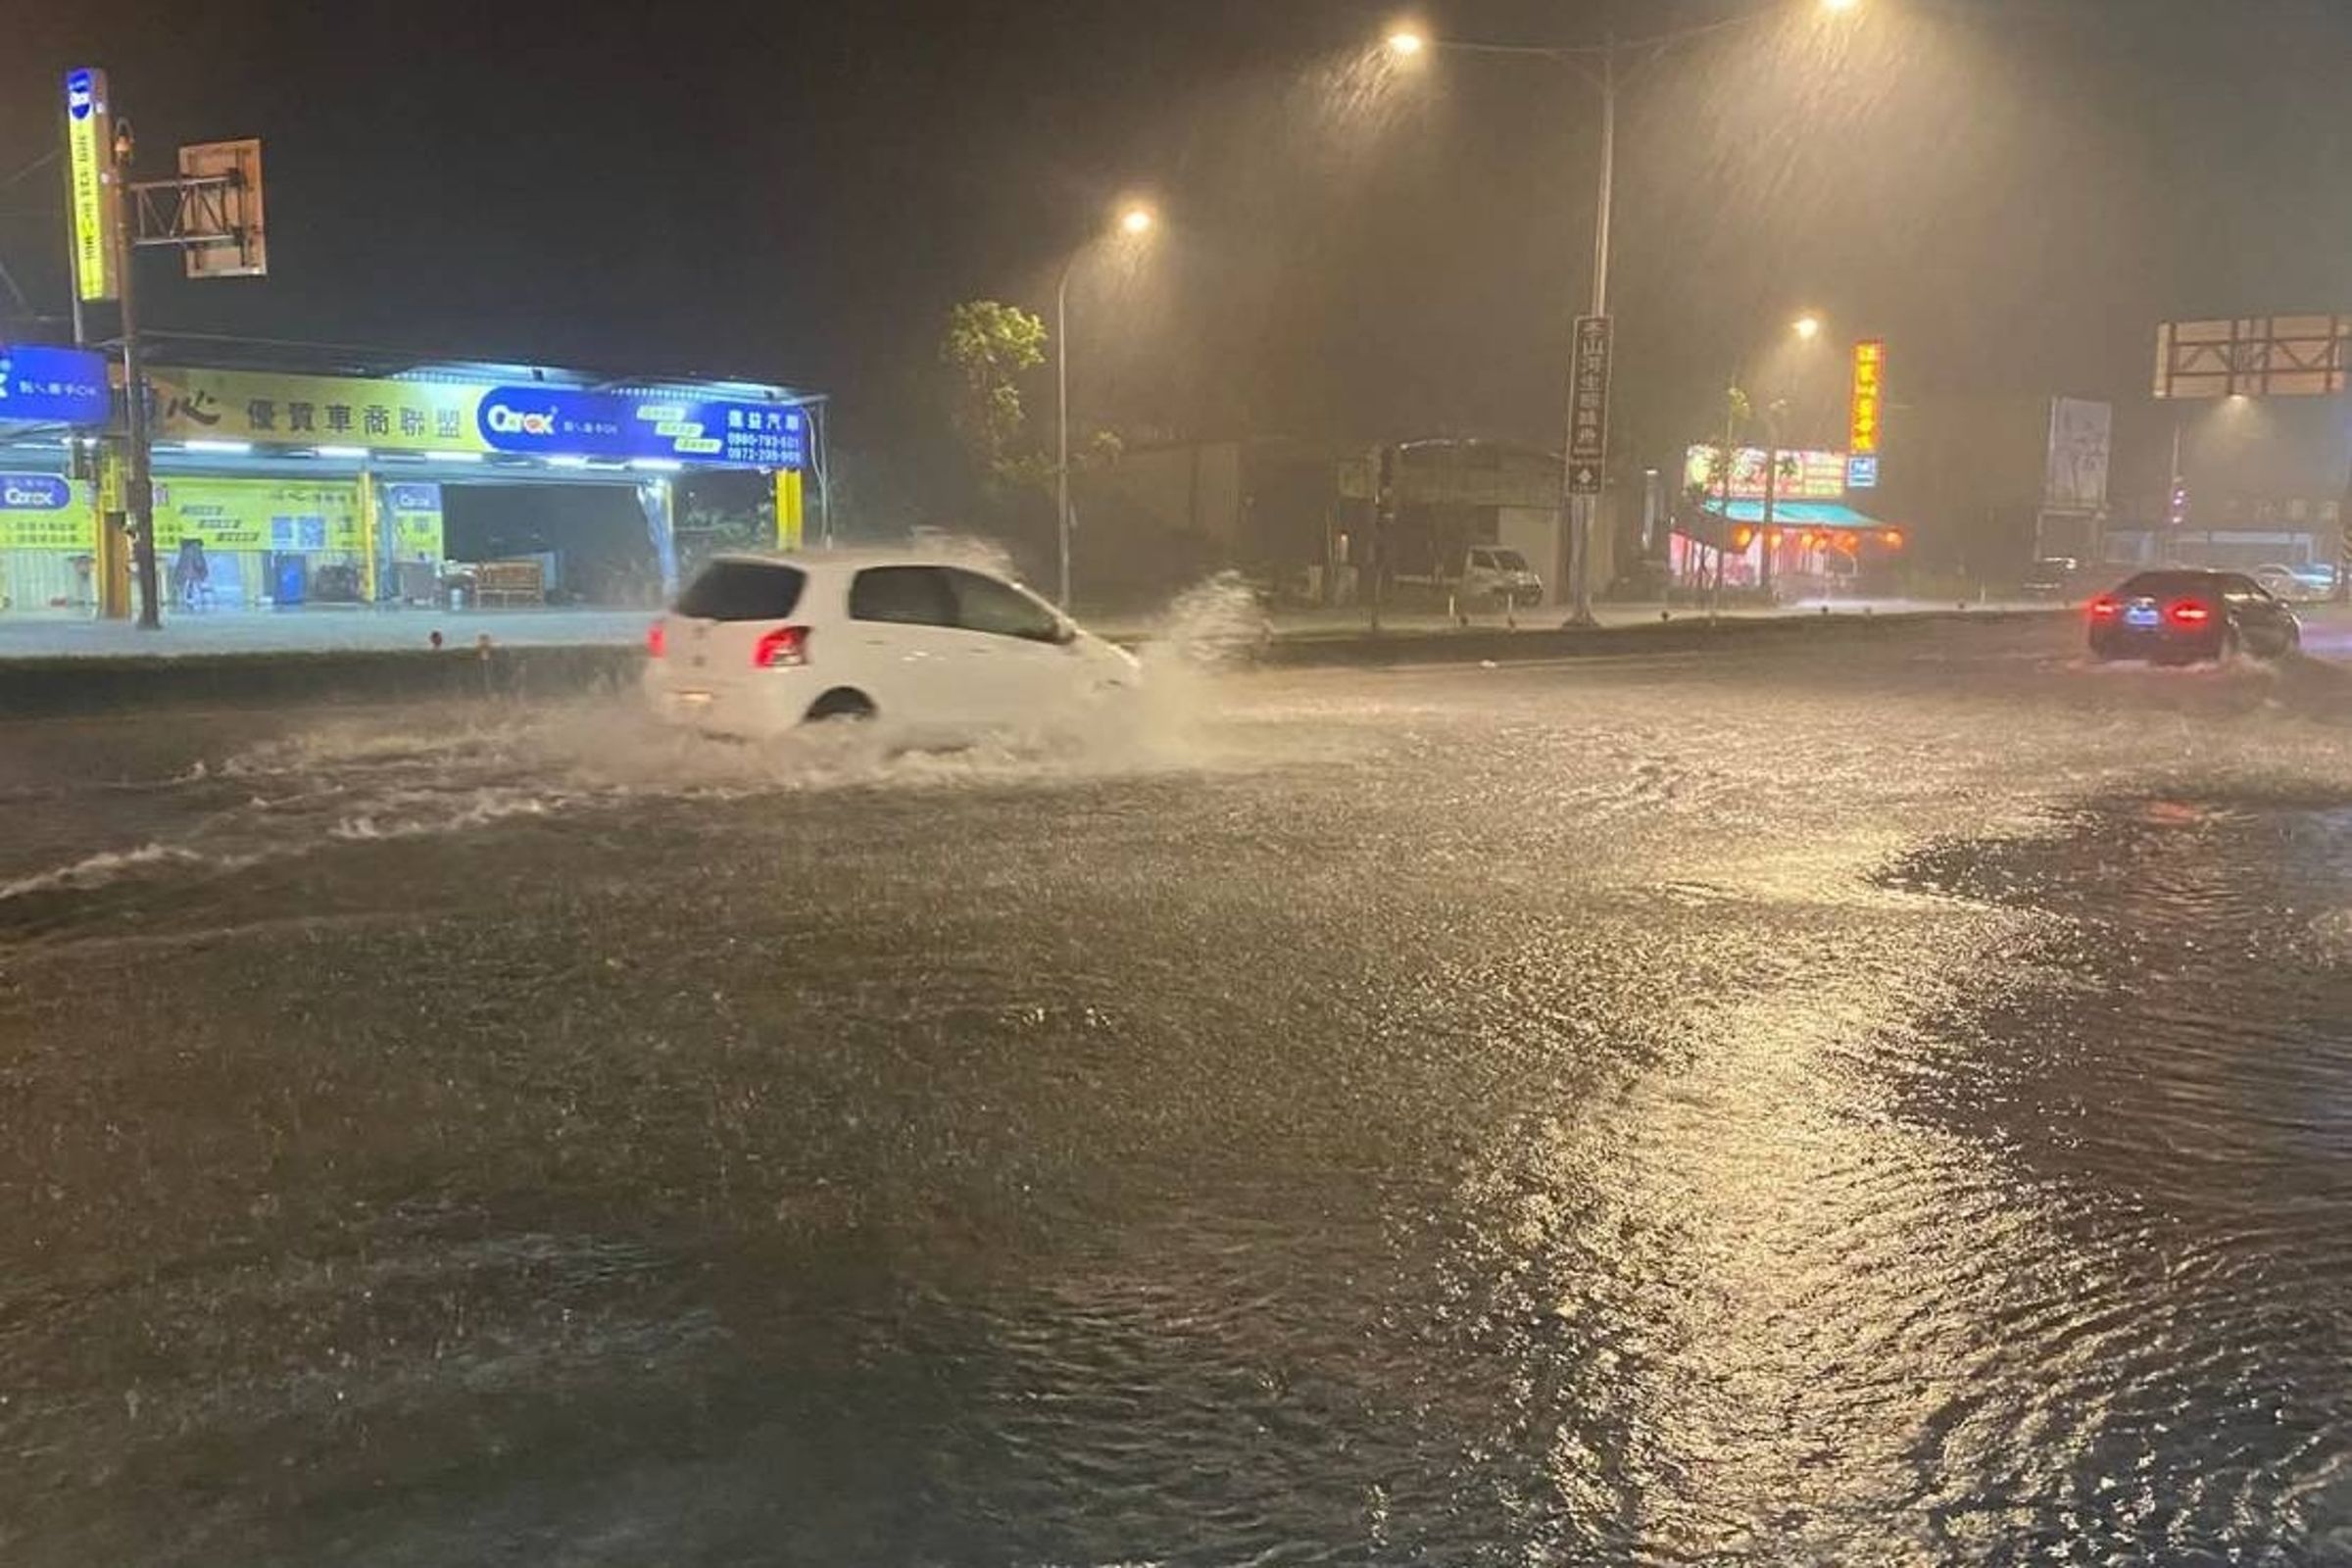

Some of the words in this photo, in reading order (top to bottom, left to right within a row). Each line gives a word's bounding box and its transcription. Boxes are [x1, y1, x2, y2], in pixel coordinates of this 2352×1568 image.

[247, 399, 461, 439] 優質車商聯盟
